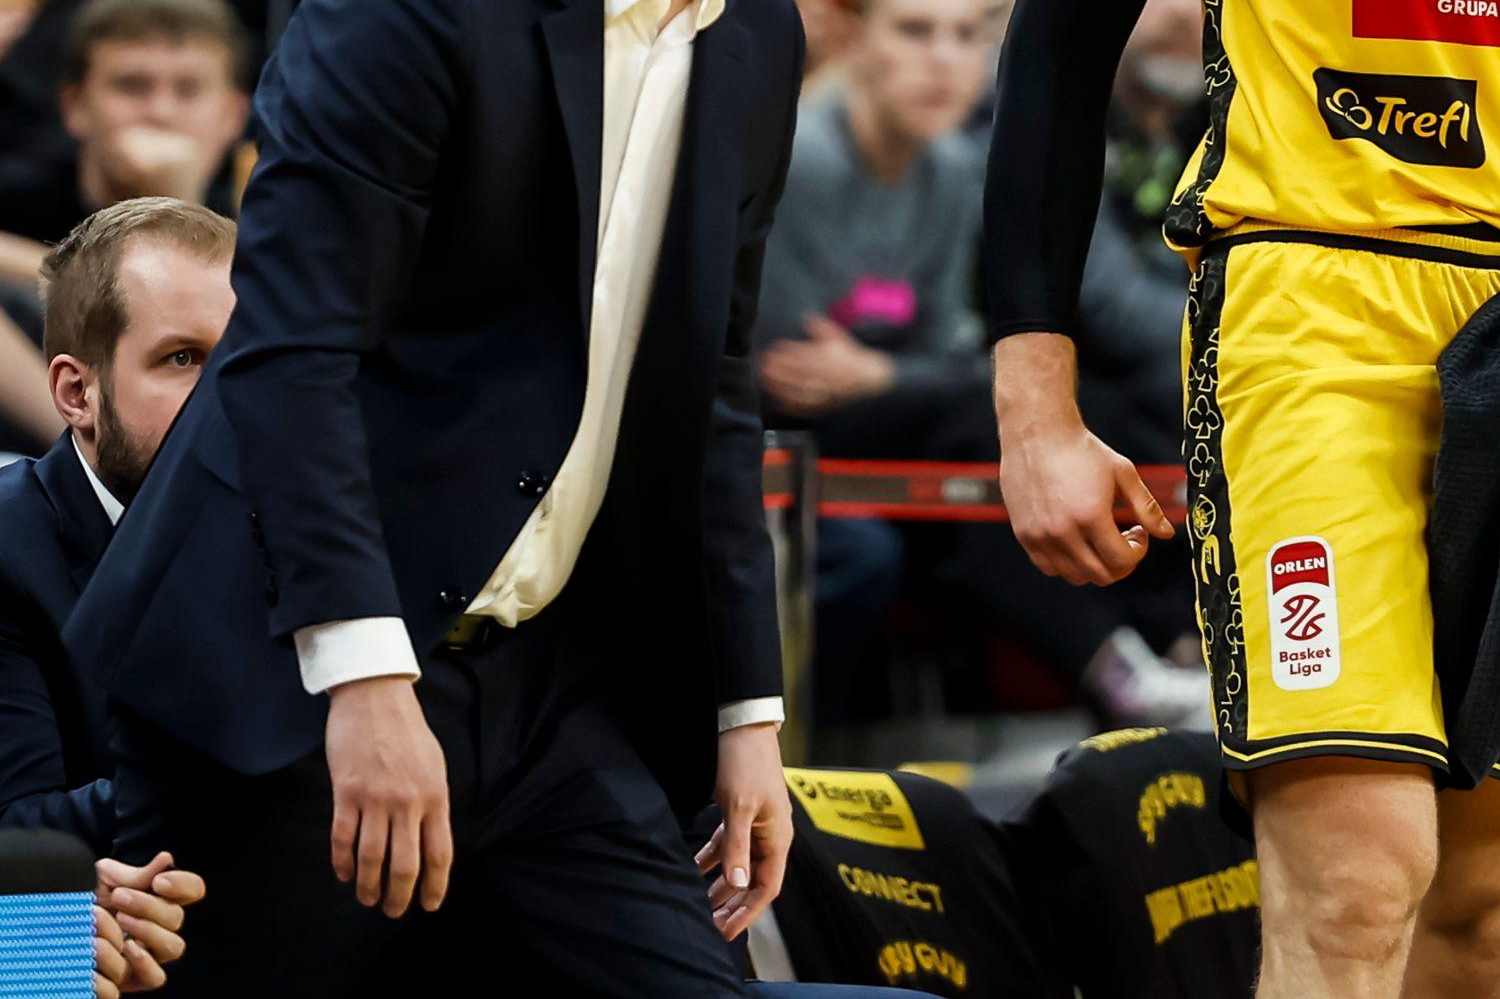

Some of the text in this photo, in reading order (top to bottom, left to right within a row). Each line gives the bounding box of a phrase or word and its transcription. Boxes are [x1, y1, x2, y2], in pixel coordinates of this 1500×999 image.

[1375, 96, 1470, 149] Trefl
[1274, 556, 1326, 576] ORLEN
[1279, 646, 1332, 663] Basket
[1289, 662, 1322, 677] Liga
[837, 862, 945, 914] CONNECT
